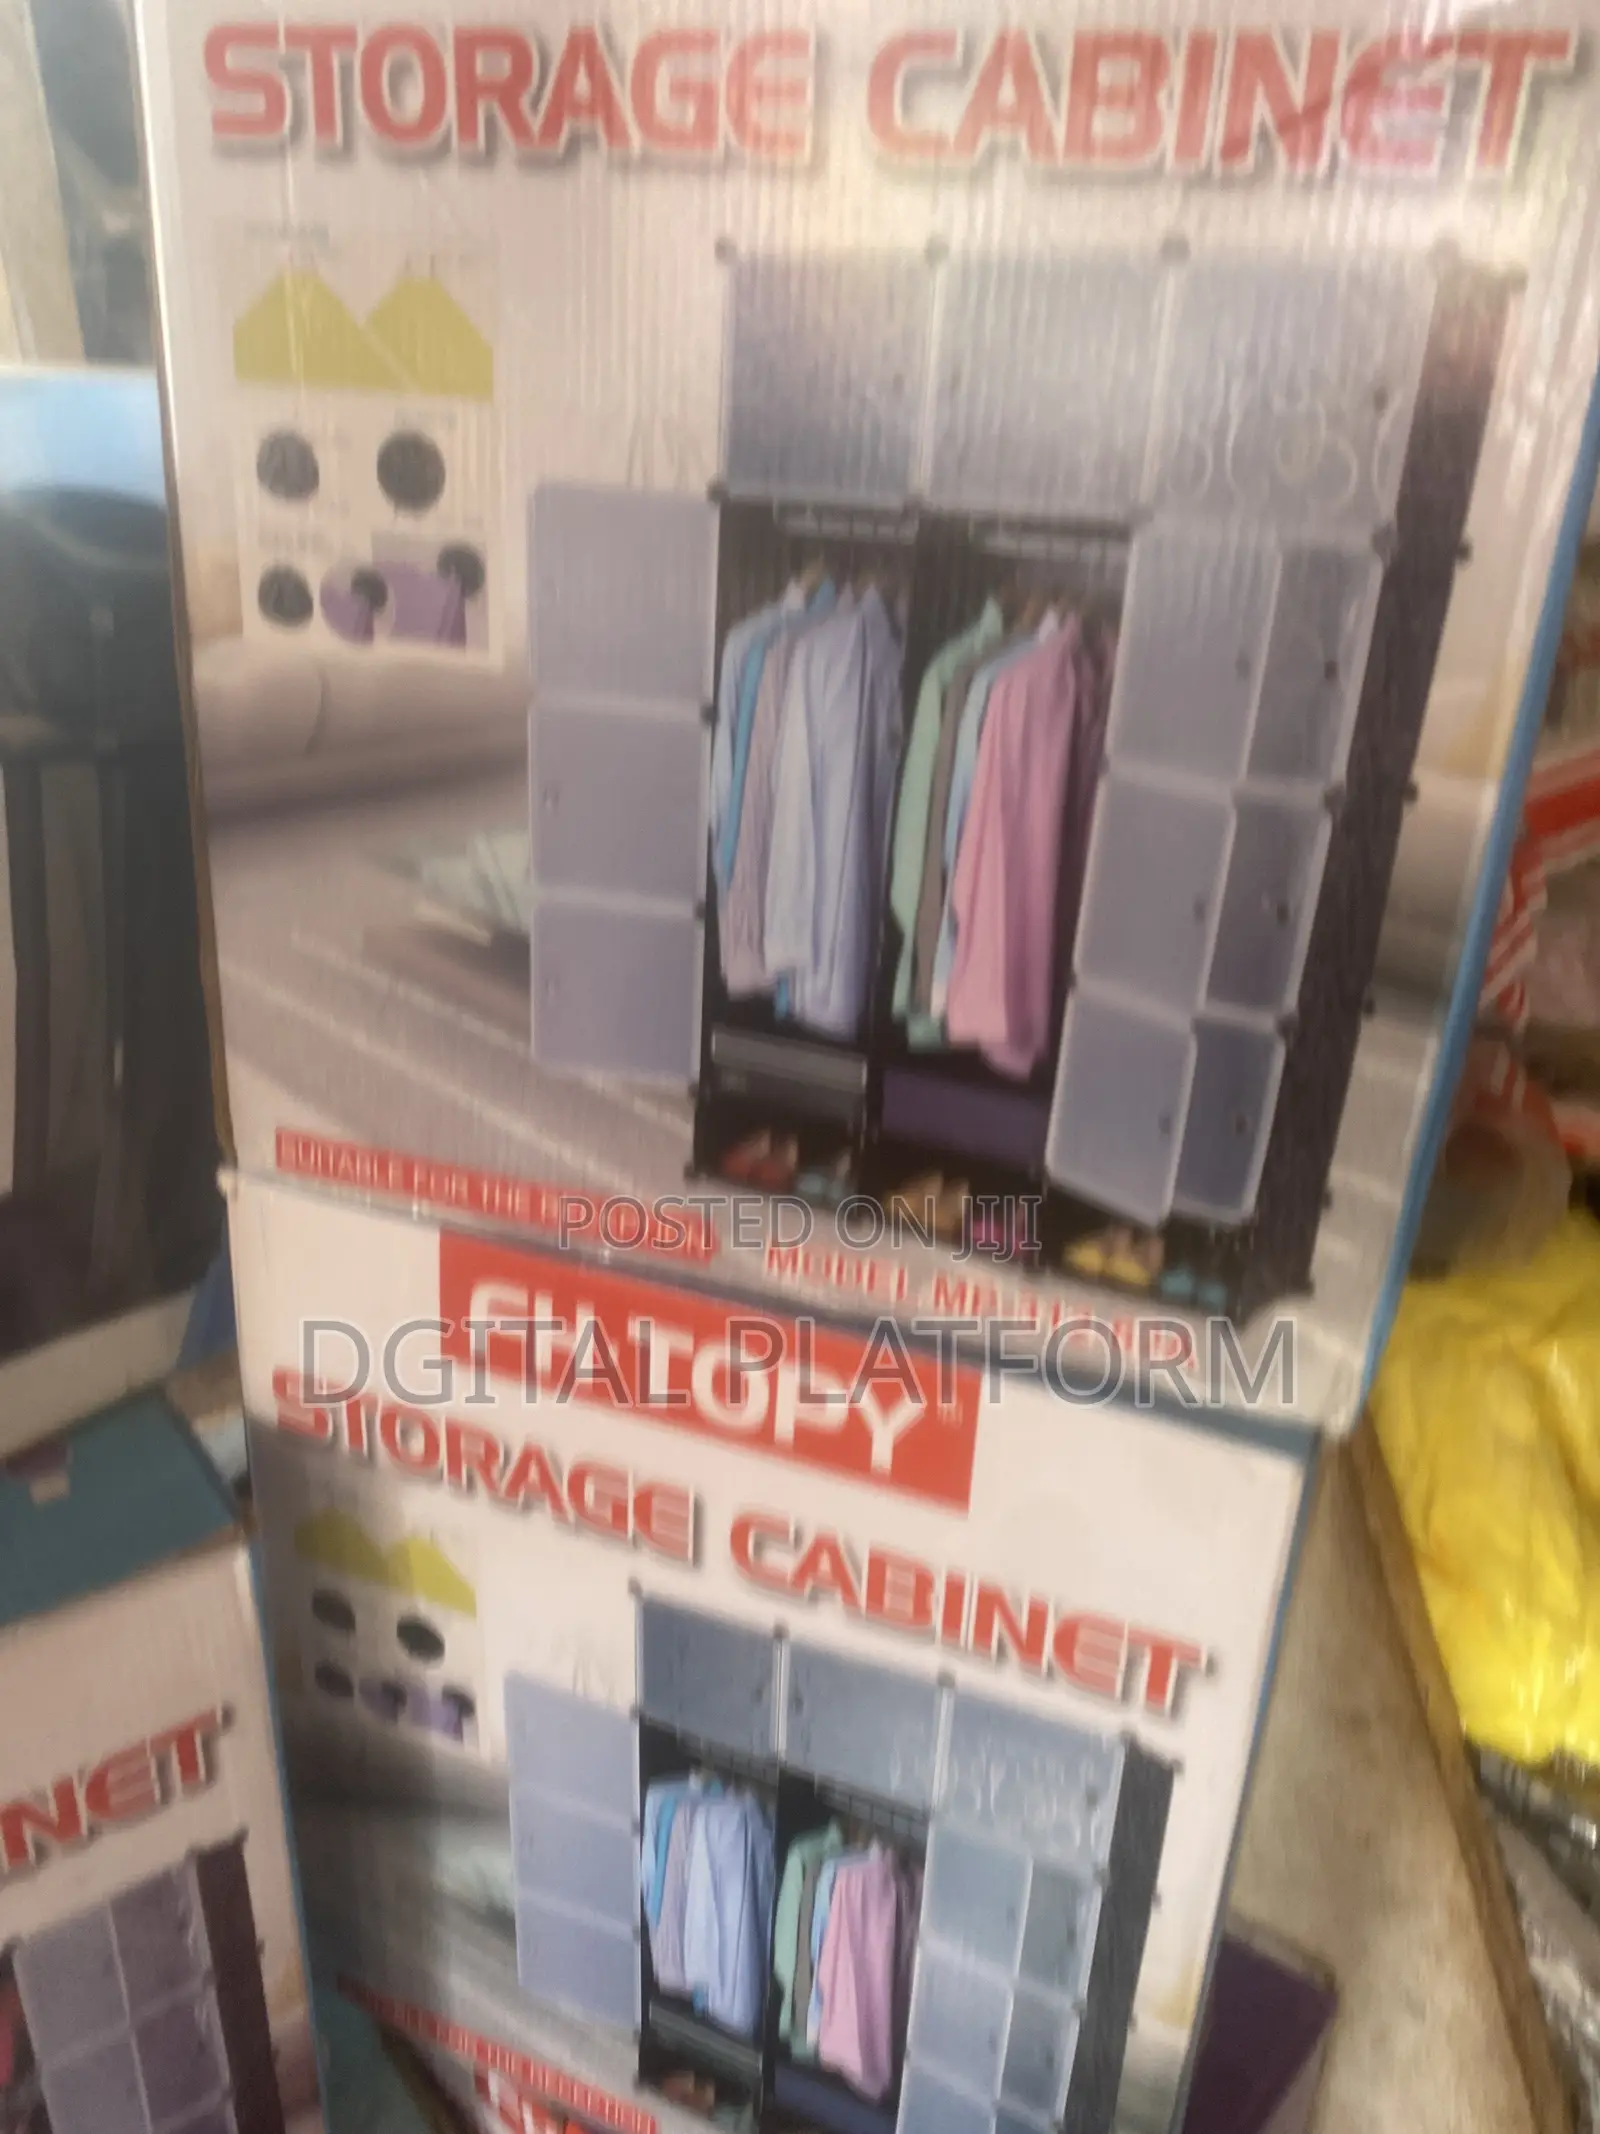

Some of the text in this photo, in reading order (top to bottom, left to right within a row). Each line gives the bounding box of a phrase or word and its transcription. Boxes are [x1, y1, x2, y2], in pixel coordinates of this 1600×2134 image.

[203, 22, 1578, 174] STORAGE CABINET
[272, 1365, 1212, 1714] STORAGE CABINET
